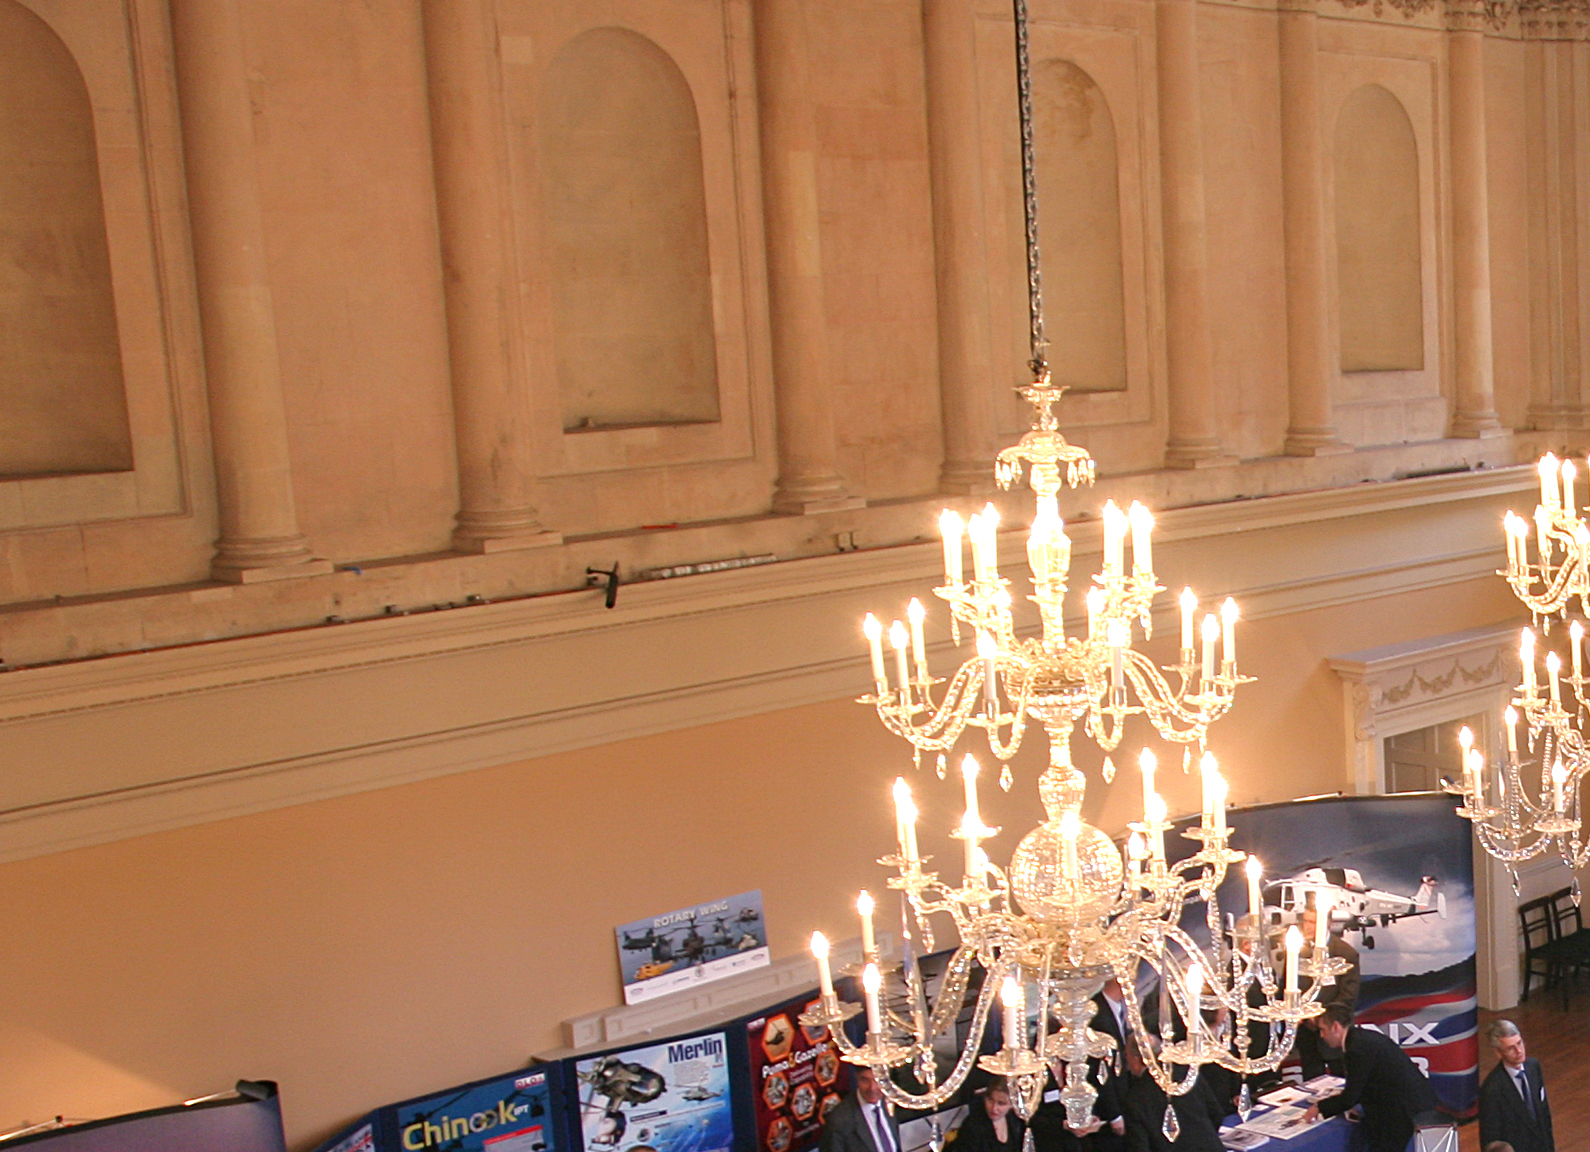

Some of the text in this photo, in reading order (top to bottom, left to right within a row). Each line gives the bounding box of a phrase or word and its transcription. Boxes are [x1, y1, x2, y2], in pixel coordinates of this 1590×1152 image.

[653, 899, 729, 928] ROTARY WING
[667, 1037, 723, 1064] Merlin
[402, 1100, 518, 1151] Chinook
[513, 1104, 529, 1116] IPT
